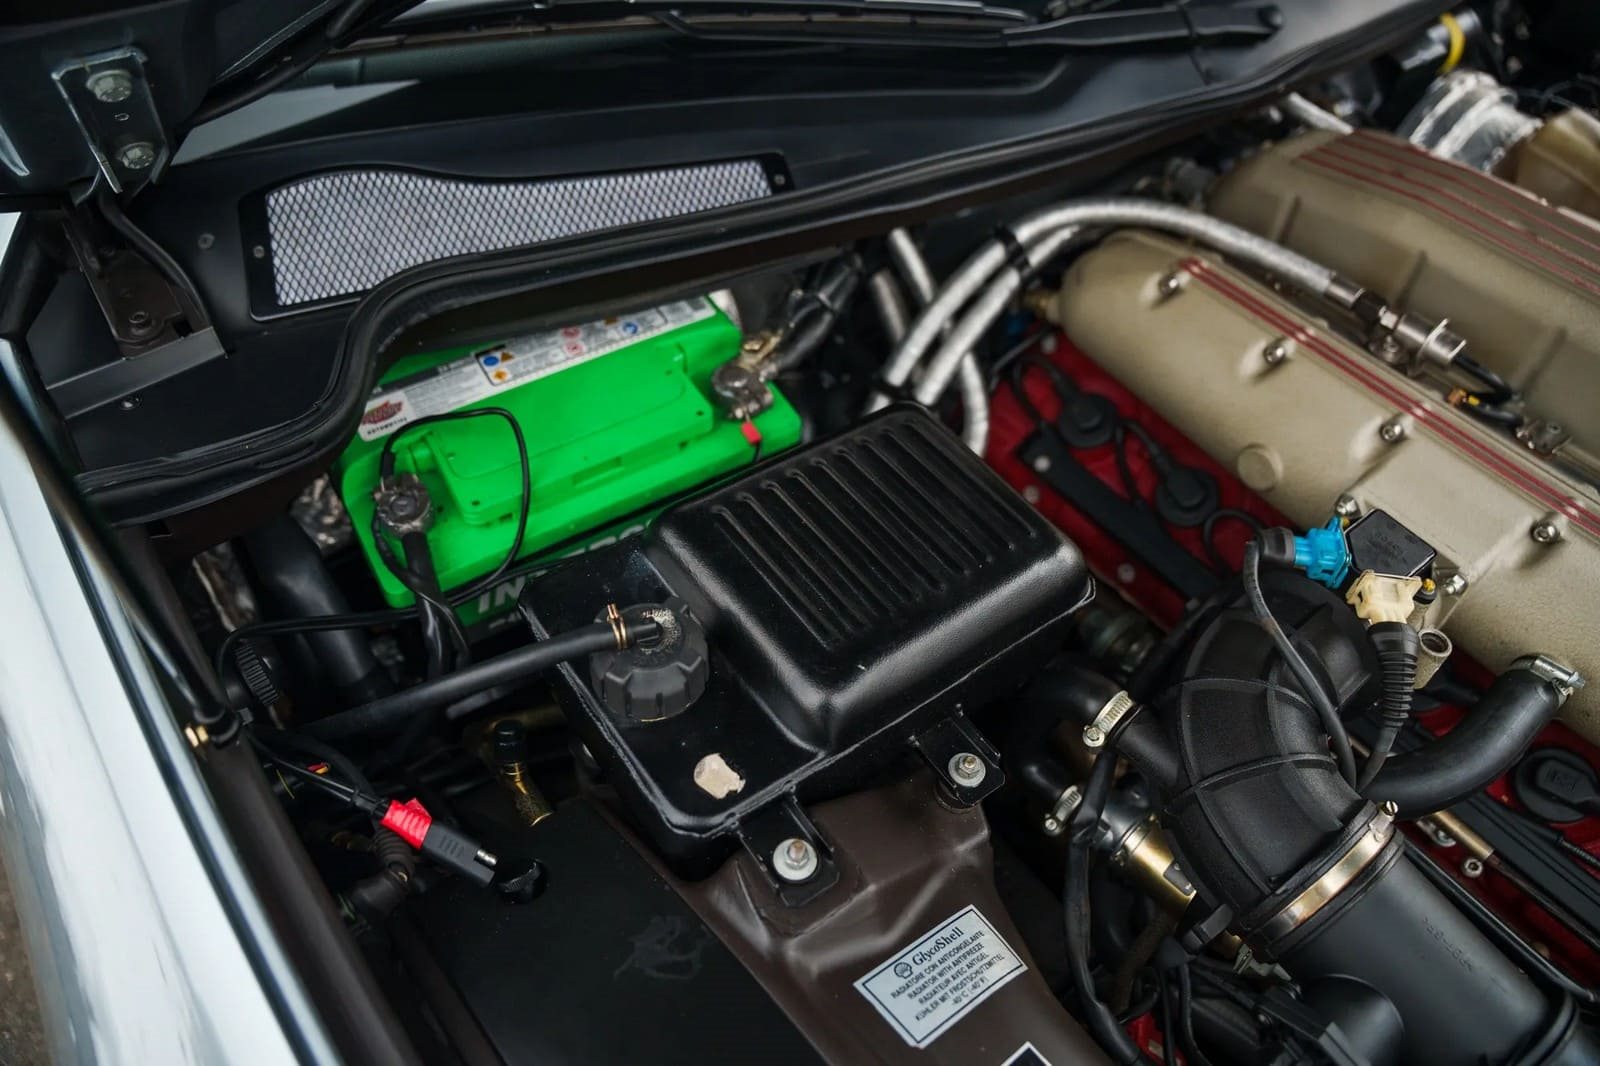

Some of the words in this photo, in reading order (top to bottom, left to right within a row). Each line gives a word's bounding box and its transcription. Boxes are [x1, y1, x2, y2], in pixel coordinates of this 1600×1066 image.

[890, 970, 925, 998] RADIATORE
[924, 961, 938, 974] CON
[937, 930, 984, 965] ANTICONGELANTE
[908, 974, 938, 999] RADIATOR
[936, 963, 953, 977] WITH
[952, 942, 984, 967] ANTIFREEZE
[912, 926, 964, 965] GlycoShell
[918, 979, 951, 1004] RADIATEUR
[950, 966, 966, 980] AVEC
[965, 952, 988, 969] ANTIGEL
[949, 954, 1004, 995] FROSTSCHUTZMITTEL
